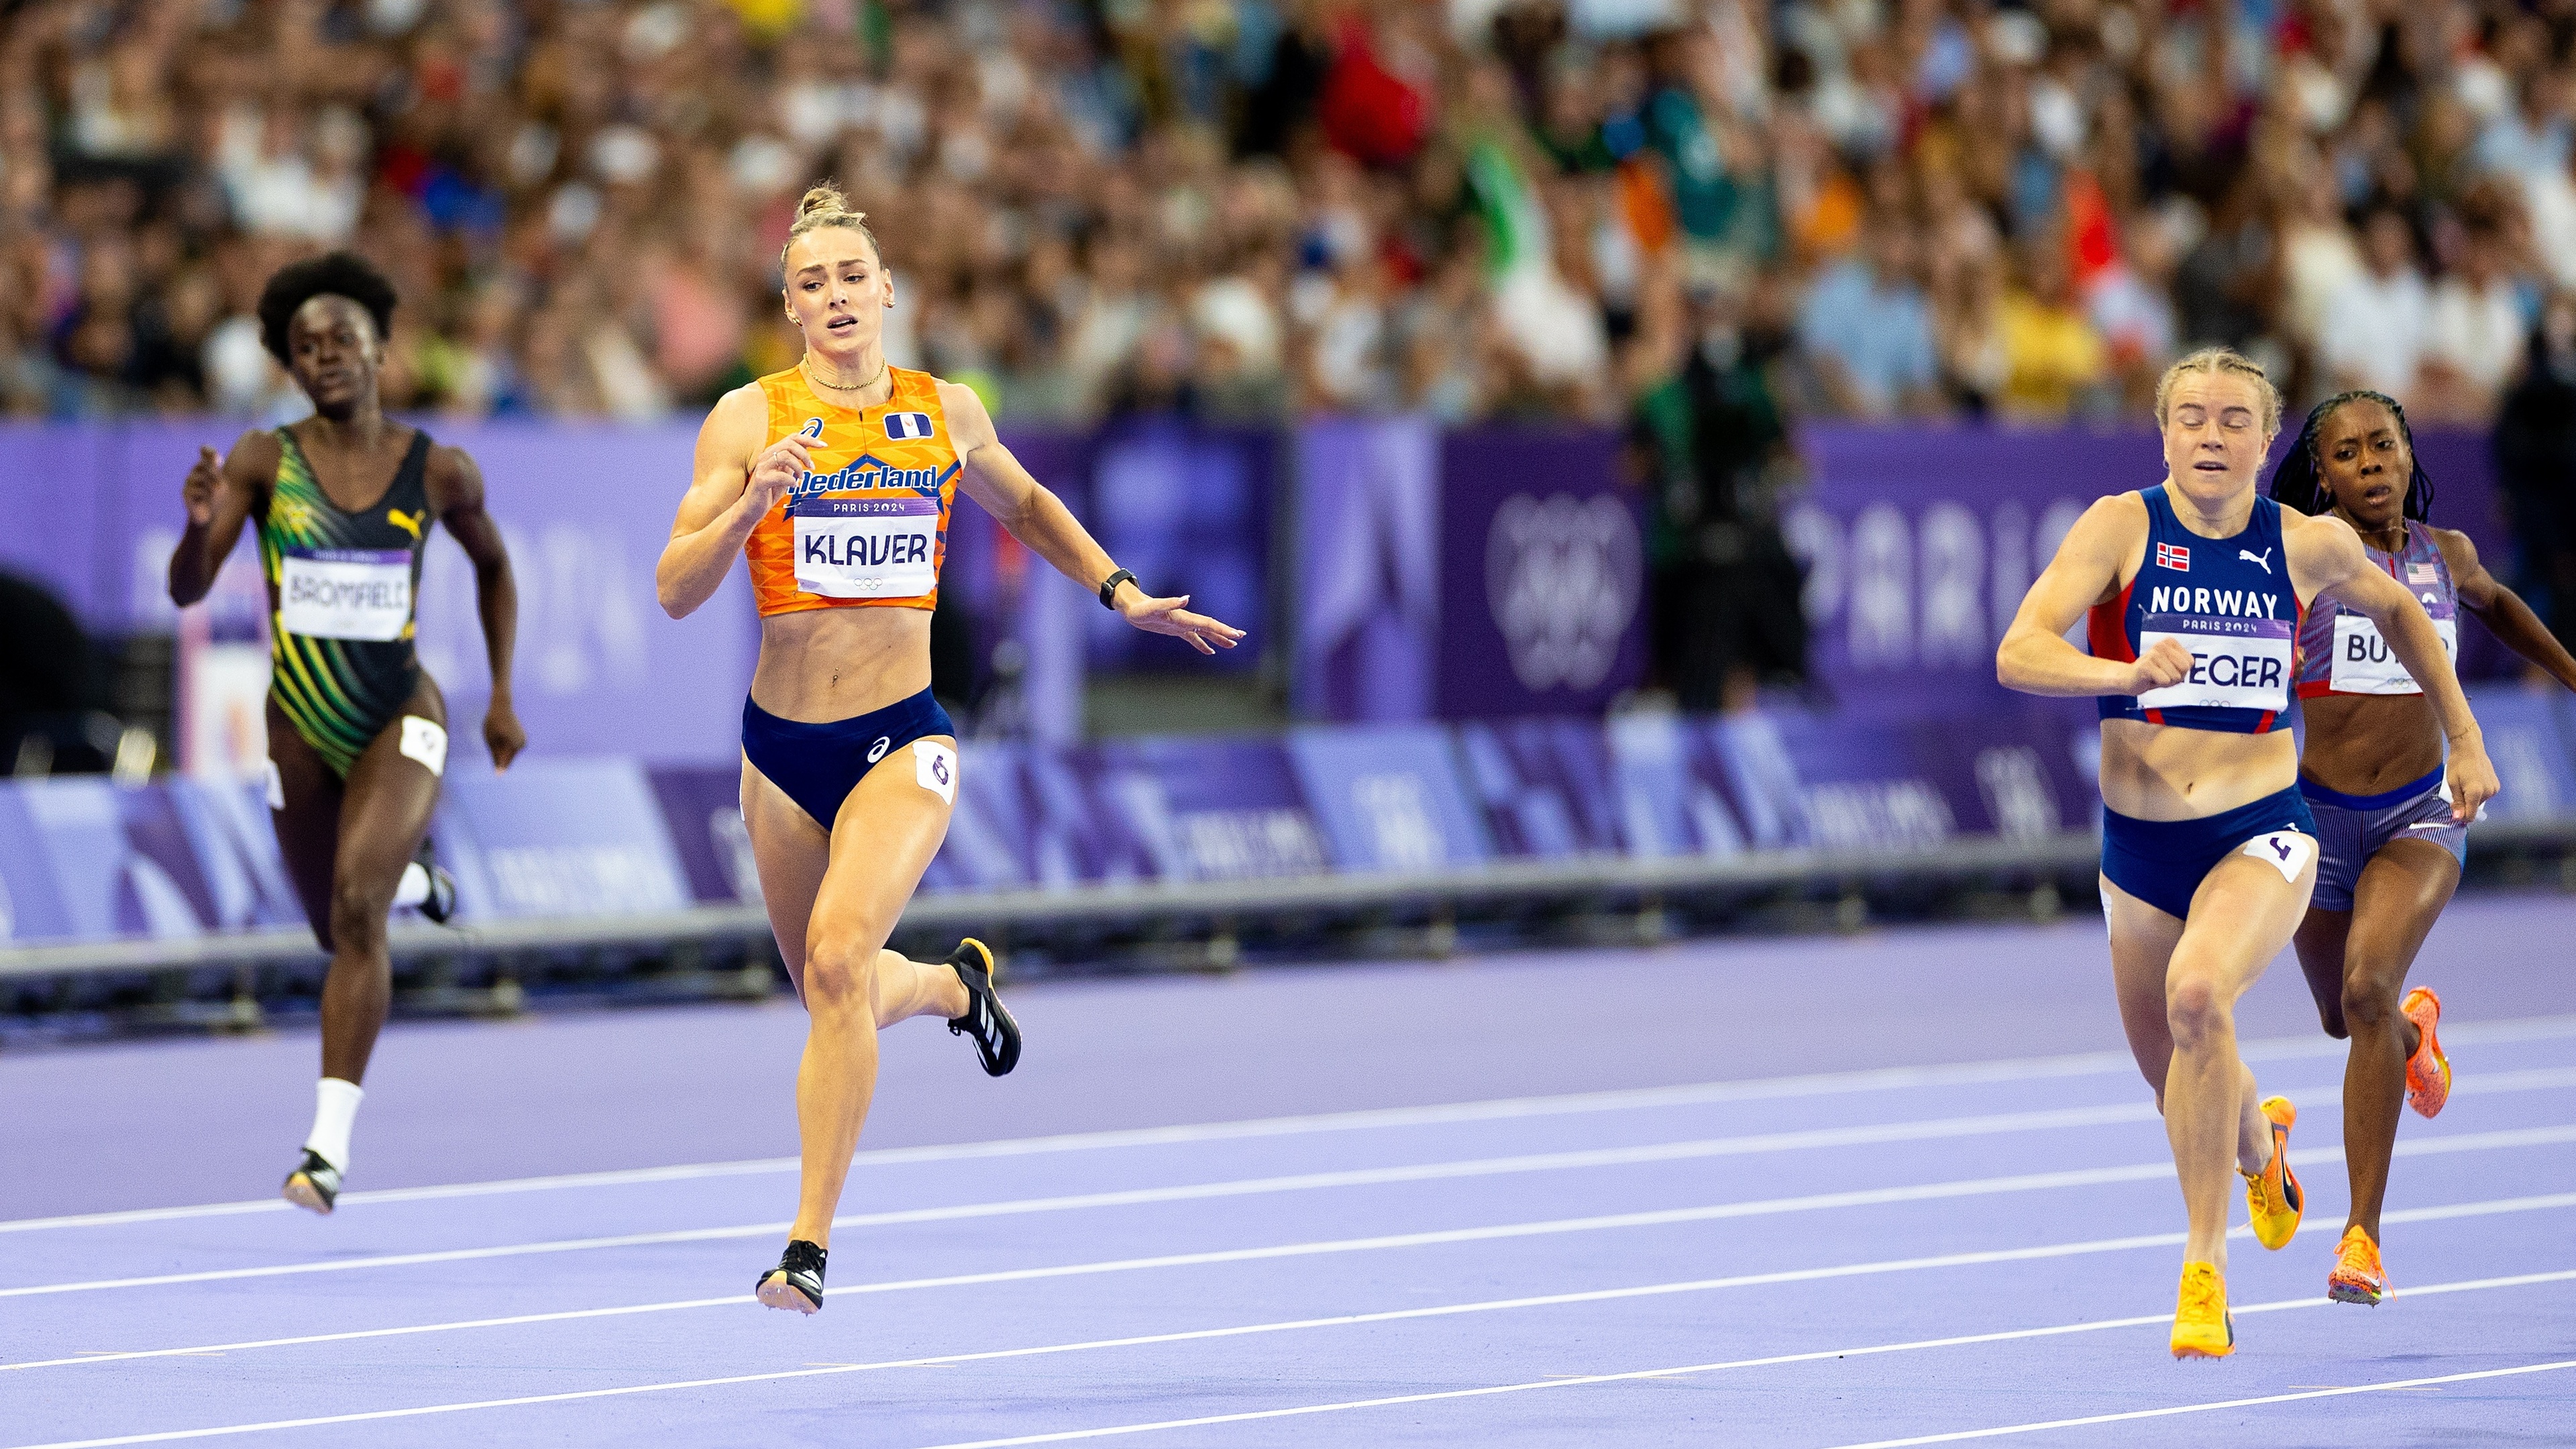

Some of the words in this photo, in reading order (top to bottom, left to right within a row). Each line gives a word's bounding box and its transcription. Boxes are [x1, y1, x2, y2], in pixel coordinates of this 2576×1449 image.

[787, 466, 938, 495] Nederland
[833, 503, 869, 512] PARIS
[873, 502, 905, 512] 2024
[805, 534, 928, 566] KLAVER
[2151, 586, 2277, 621] NORWAY
[2183, 619, 2220, 631] PARIS
[2225, 621, 2257, 633] 2024
[2180, 653, 2282, 688] EGER
[932, 755, 949, 785] 6
[2269, 837, 2292, 861] 4
